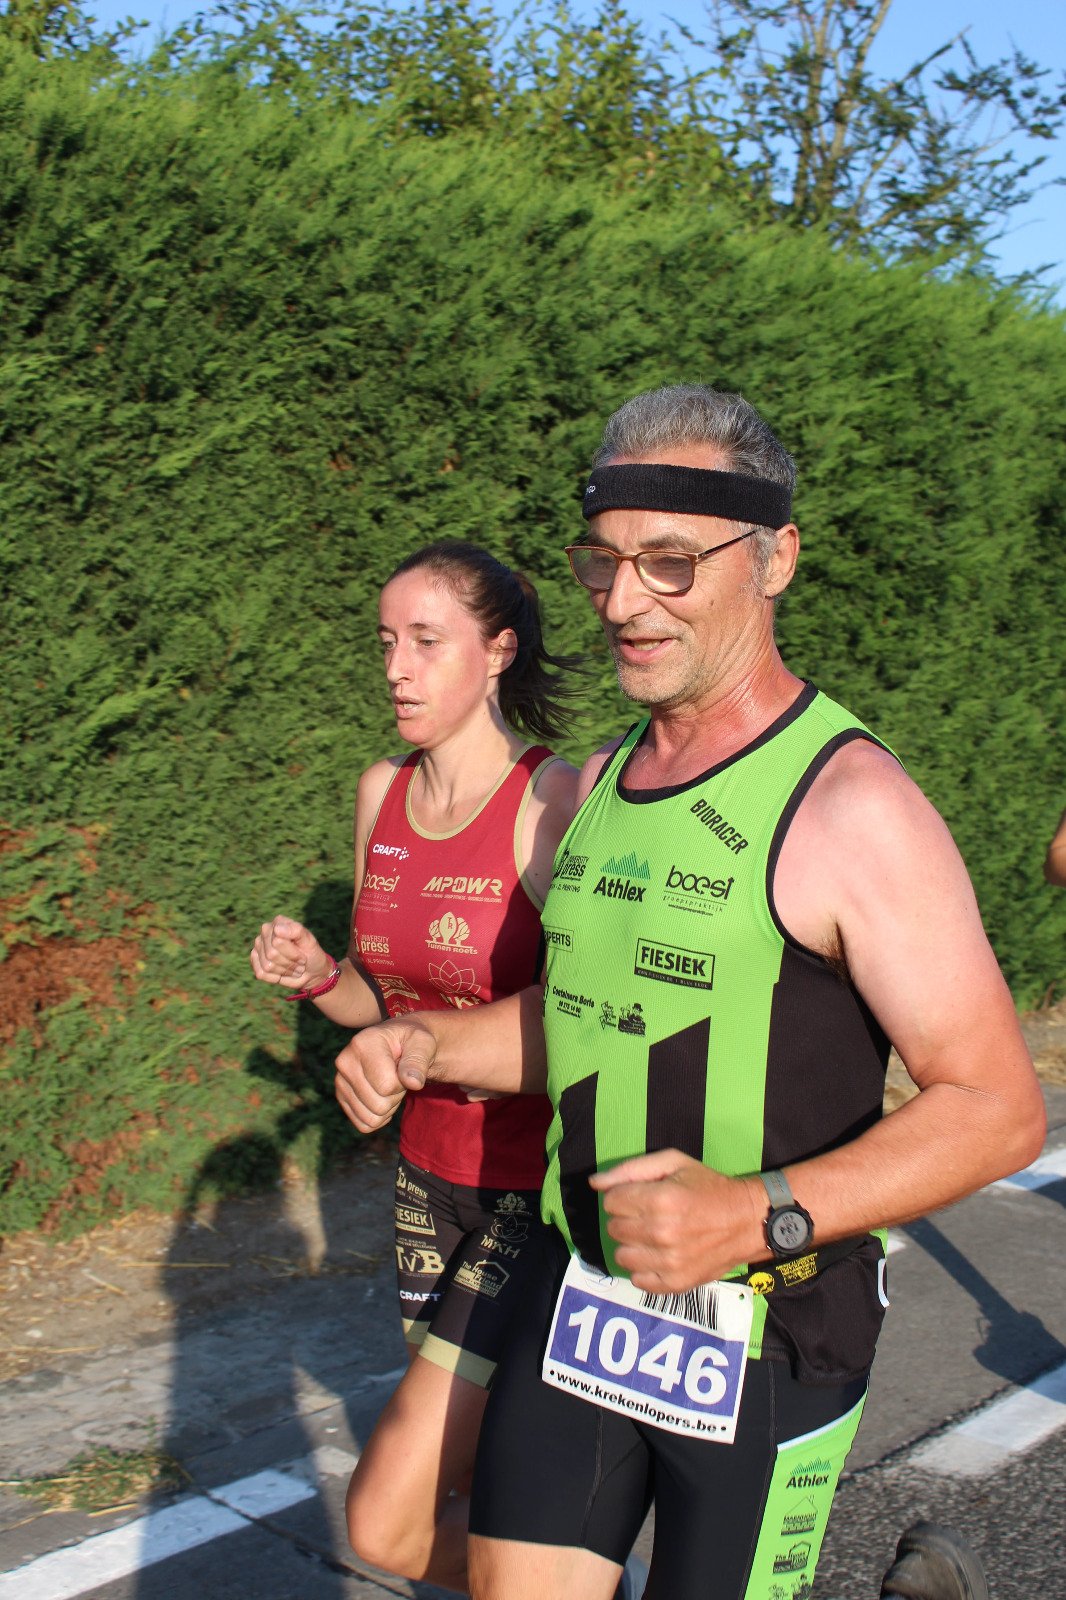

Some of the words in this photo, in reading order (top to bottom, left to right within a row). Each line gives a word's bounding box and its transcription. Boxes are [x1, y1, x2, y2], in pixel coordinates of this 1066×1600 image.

[690, 798, 749, 855] BIORACER
[372, 843, 402, 857] CRAFT
[422, 876, 503, 896] MPOWR
[593, 876, 647, 902] Athlex
[361, 940, 390, 954] press
[641, 946, 707, 977] FIESIEK
[407, 1181, 429, 1199] press
[400, 1290, 441, 1302] CRAFT
[569, 1304, 730, 1405] 1046
[556, 1370, 718, 1433] www.krekenlopers.be
[786, 1473, 829, 1489] Athlex
